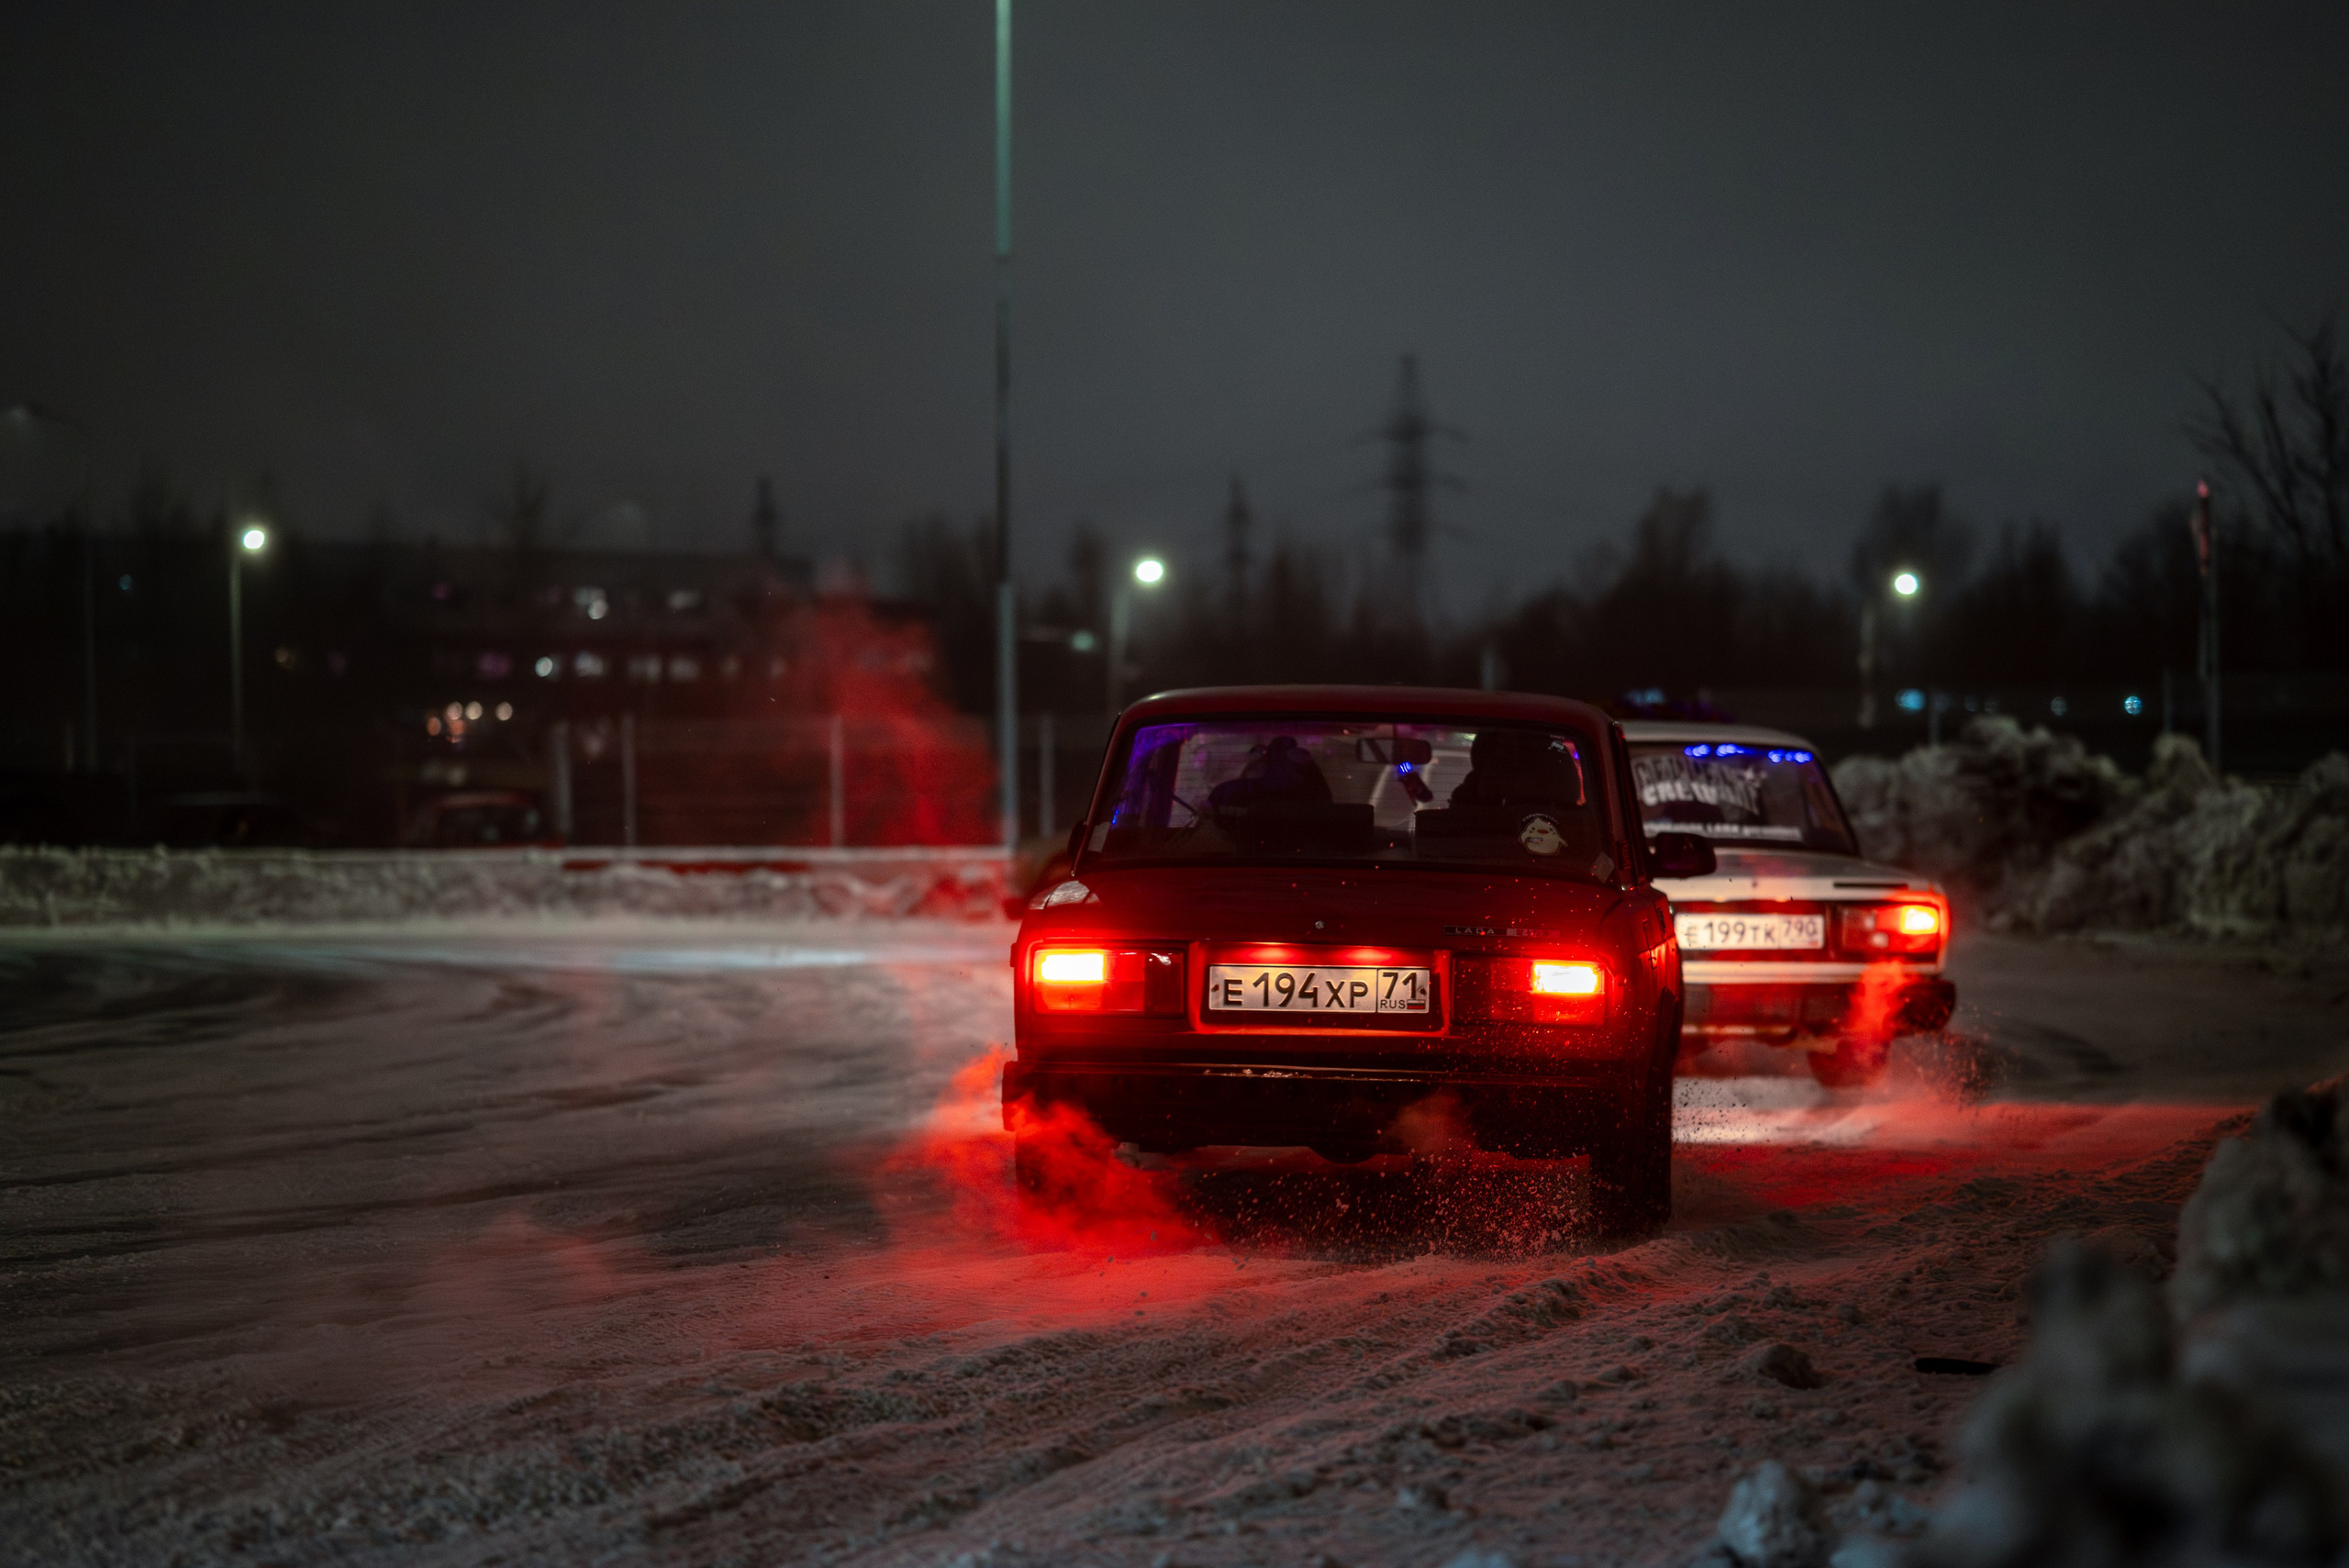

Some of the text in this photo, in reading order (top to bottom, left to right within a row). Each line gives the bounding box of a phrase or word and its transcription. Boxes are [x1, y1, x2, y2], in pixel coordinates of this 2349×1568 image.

[1455, 927, 1495, 935] LADA
[1223, 972, 1417, 1008] Е194ХР 71
[1380, 999, 1406, 1009] RUS
